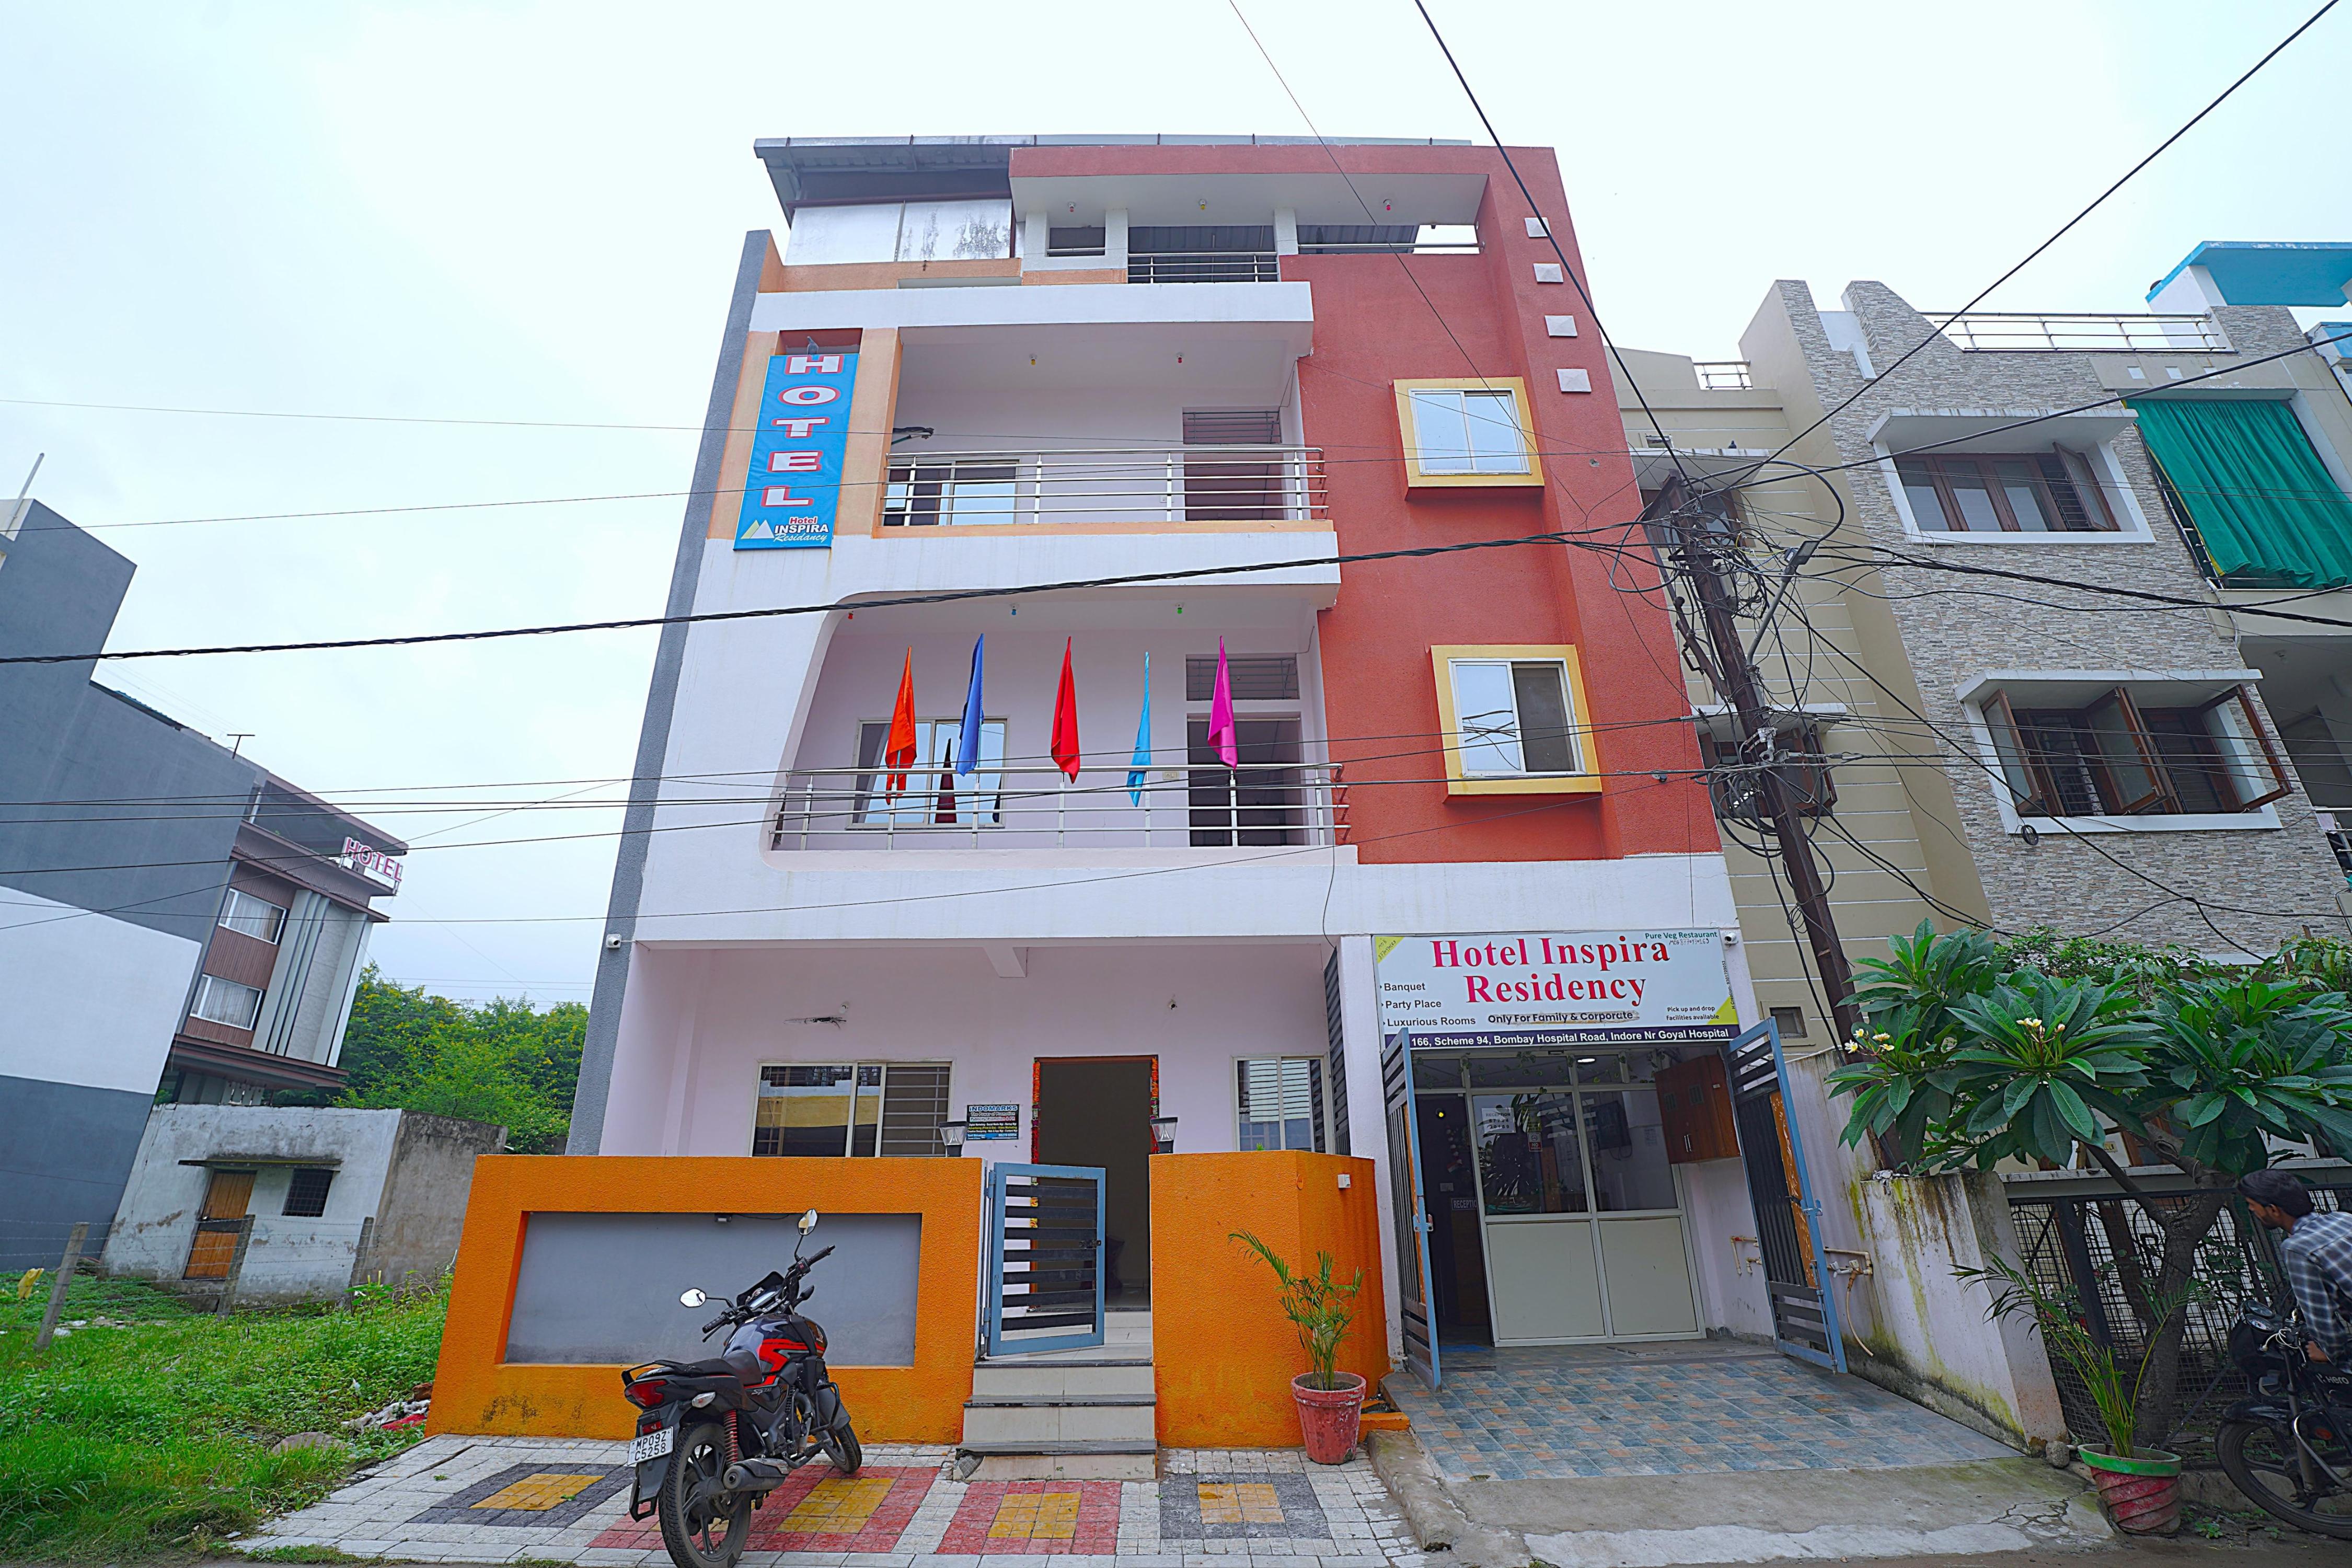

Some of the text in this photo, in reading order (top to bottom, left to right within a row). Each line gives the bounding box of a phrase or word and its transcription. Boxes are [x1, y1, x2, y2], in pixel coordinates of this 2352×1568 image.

[760, 354, 844, 507] HOTEL
[775, 524, 829, 534] INSPIRA
[343, 837, 402, 882] HOTEL
[1429, 936, 1670, 971] Hotel Inspira
[1384, 983, 1426, 993] Banquet
[1463, 973, 1646, 1007] Residency
[1386, 1000, 1442, 1010] Party Place
[1387, 1017, 1476, 1027] Luxurious Rooms
[1488, 1014, 1512, 1024] Only
[1533, 1012, 1568, 1023] Family
[1581, 1011, 1633, 1022] Corporate
[1411, 1029, 1729, 1047] 166, Scheme 94, Bombay Hospital Road, Indore Nr Goyal Hospital
[1454, 1200, 1478, 1208] RECEPTIO
[636, 1431, 666, 1450] MP09Z
[635, 1443, 666, 1461] C5258
